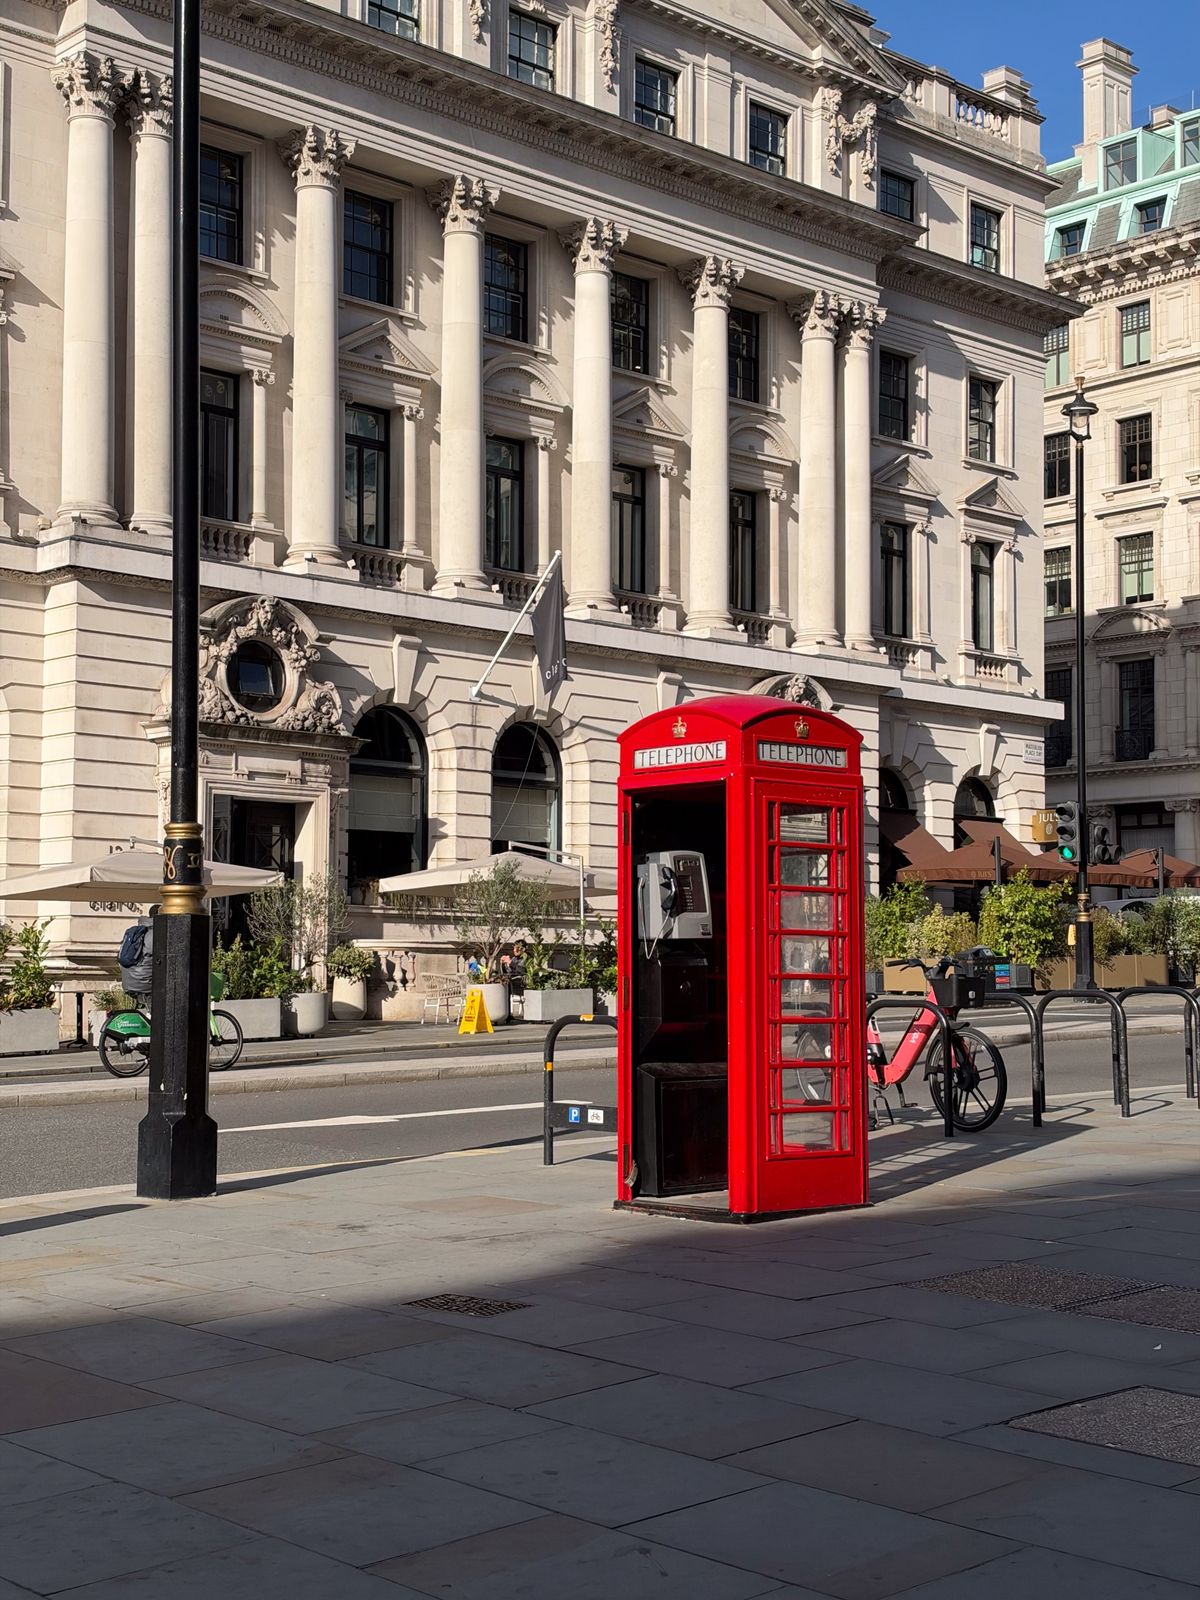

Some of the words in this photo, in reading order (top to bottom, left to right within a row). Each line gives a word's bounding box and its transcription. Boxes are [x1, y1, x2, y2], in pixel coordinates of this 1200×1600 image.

[639, 743, 723, 767] TELEPHONE
[759, 742, 842, 766] TELEPHONE
[571, 1109, 578, 1121] P
